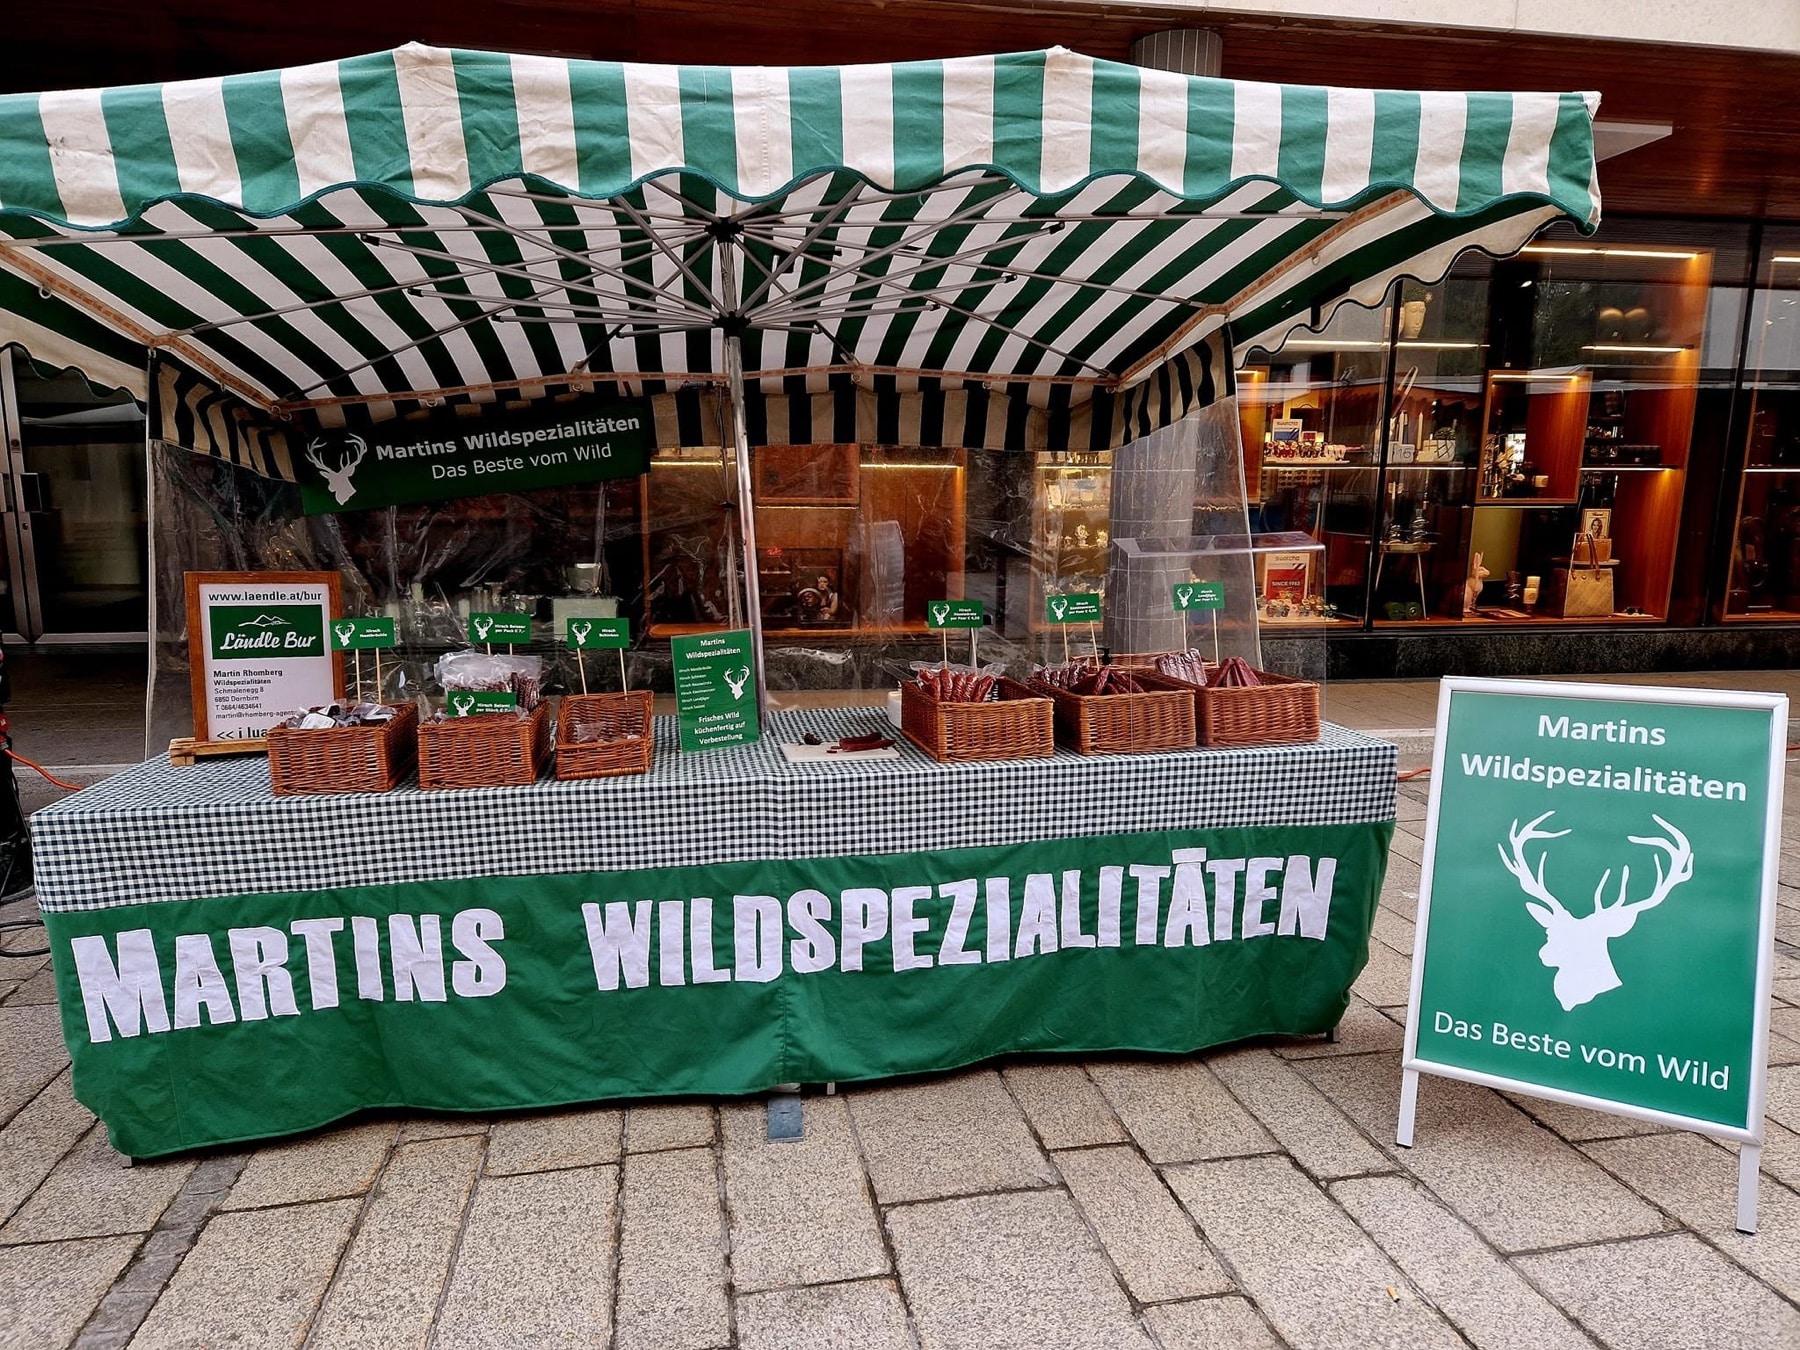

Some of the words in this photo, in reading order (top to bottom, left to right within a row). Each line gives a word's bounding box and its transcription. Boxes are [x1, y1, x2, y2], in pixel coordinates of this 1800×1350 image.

[376, 438, 457, 460] Martins
[464, 416, 640, 450] Wildspezialitäten
[432, 463, 467, 480] Das
[474, 456, 524, 475] Beste
[530, 451, 568, 468] vom
[573, 443, 612, 461] Wild
[209, 591, 322, 601] www.laendle.at/bur
[220, 632, 280, 650] Ländle
[284, 631, 316, 648] Bur
[686, 648, 740, 659] Wildspezialitäten
[243, 669, 283, 677] Rhomberg
[698, 714, 724, 723] Frisches
[694, 723, 734, 734] küchenfertig
[1538, 714, 1666, 746] Martins
[699, 734, 743, 744] Vorbestellung
[1461, 753, 1748, 802] Wildspezialitäten
[71, 908, 507, 1044] MARTINS
[1434, 1010, 1482, 1041] Das
[1492, 1024, 1571, 1059] Beste
[1580, 1044, 1646, 1075] vom
[1656, 1053, 1730, 1091] Wild
